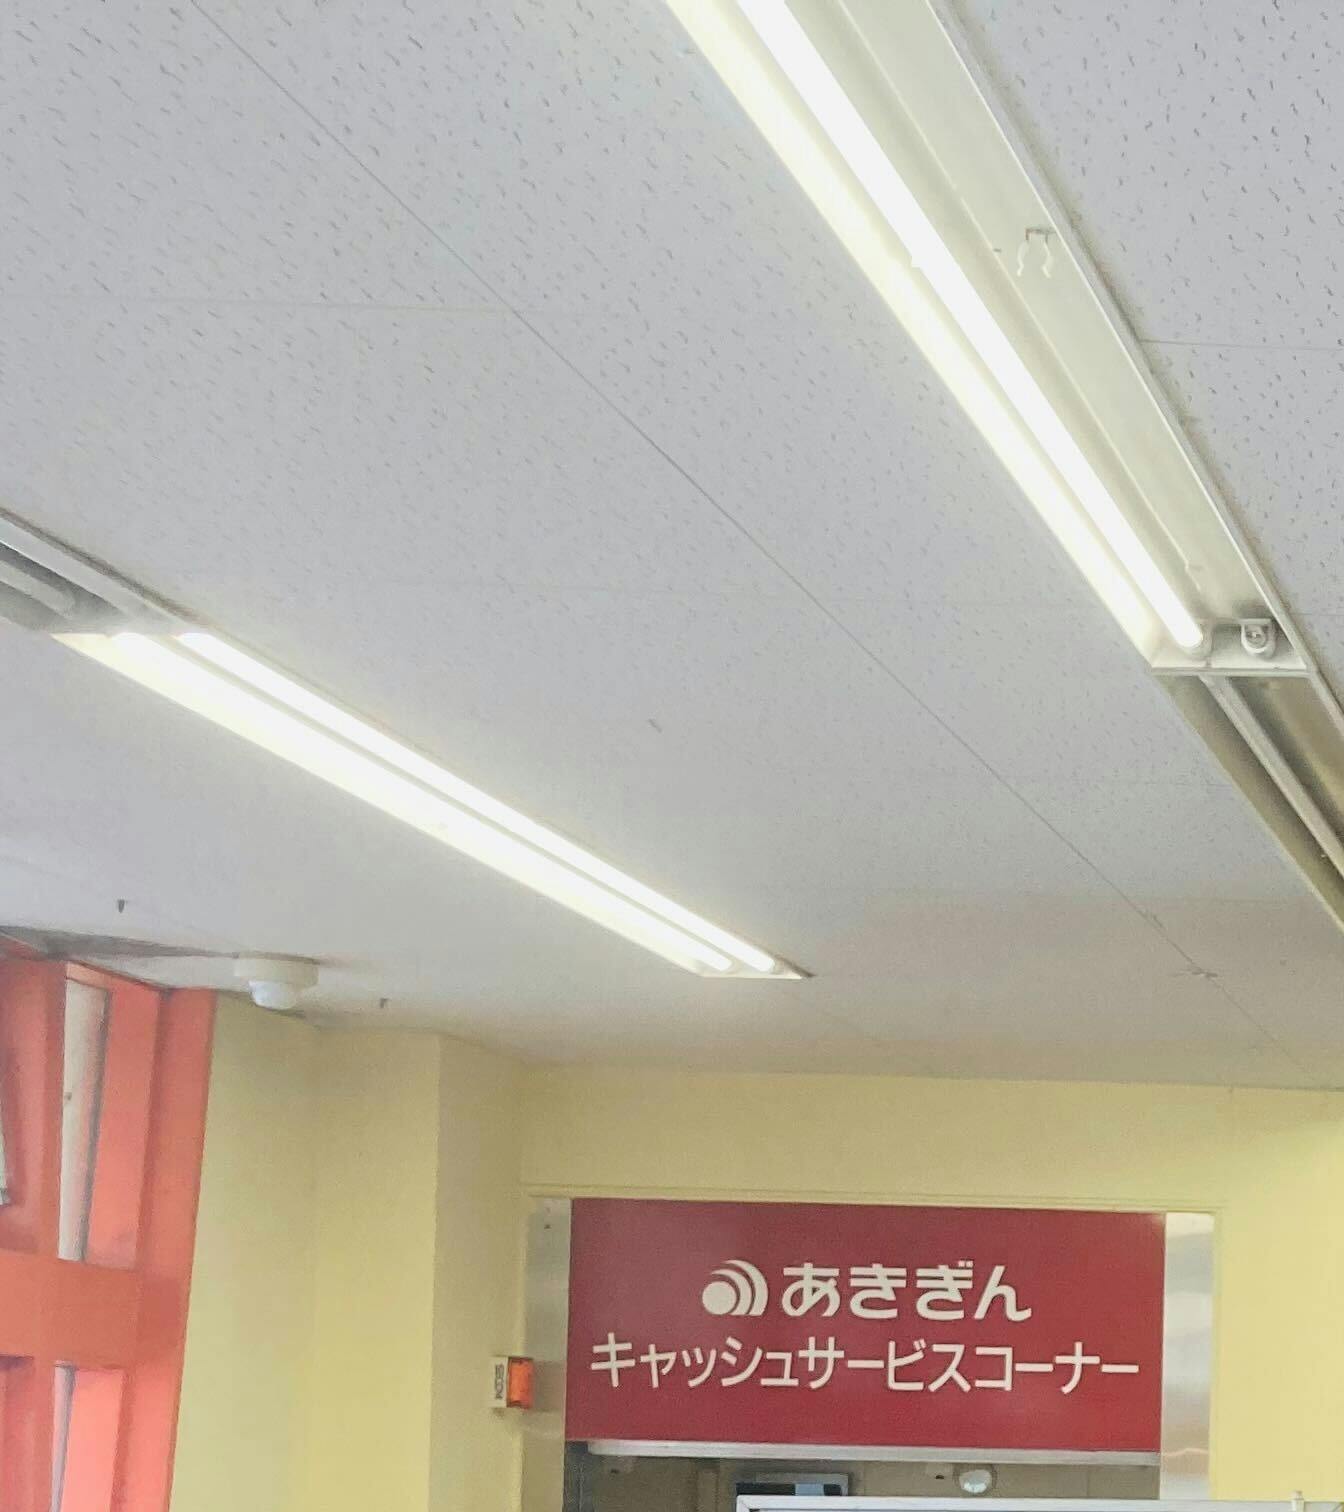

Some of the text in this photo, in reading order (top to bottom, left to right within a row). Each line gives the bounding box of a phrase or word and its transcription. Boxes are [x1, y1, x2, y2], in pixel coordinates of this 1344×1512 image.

[781, 1262, 1032, 1321] あきぎん
[591, 1332, 1139, 1393] キャッシュサービスコーナー
